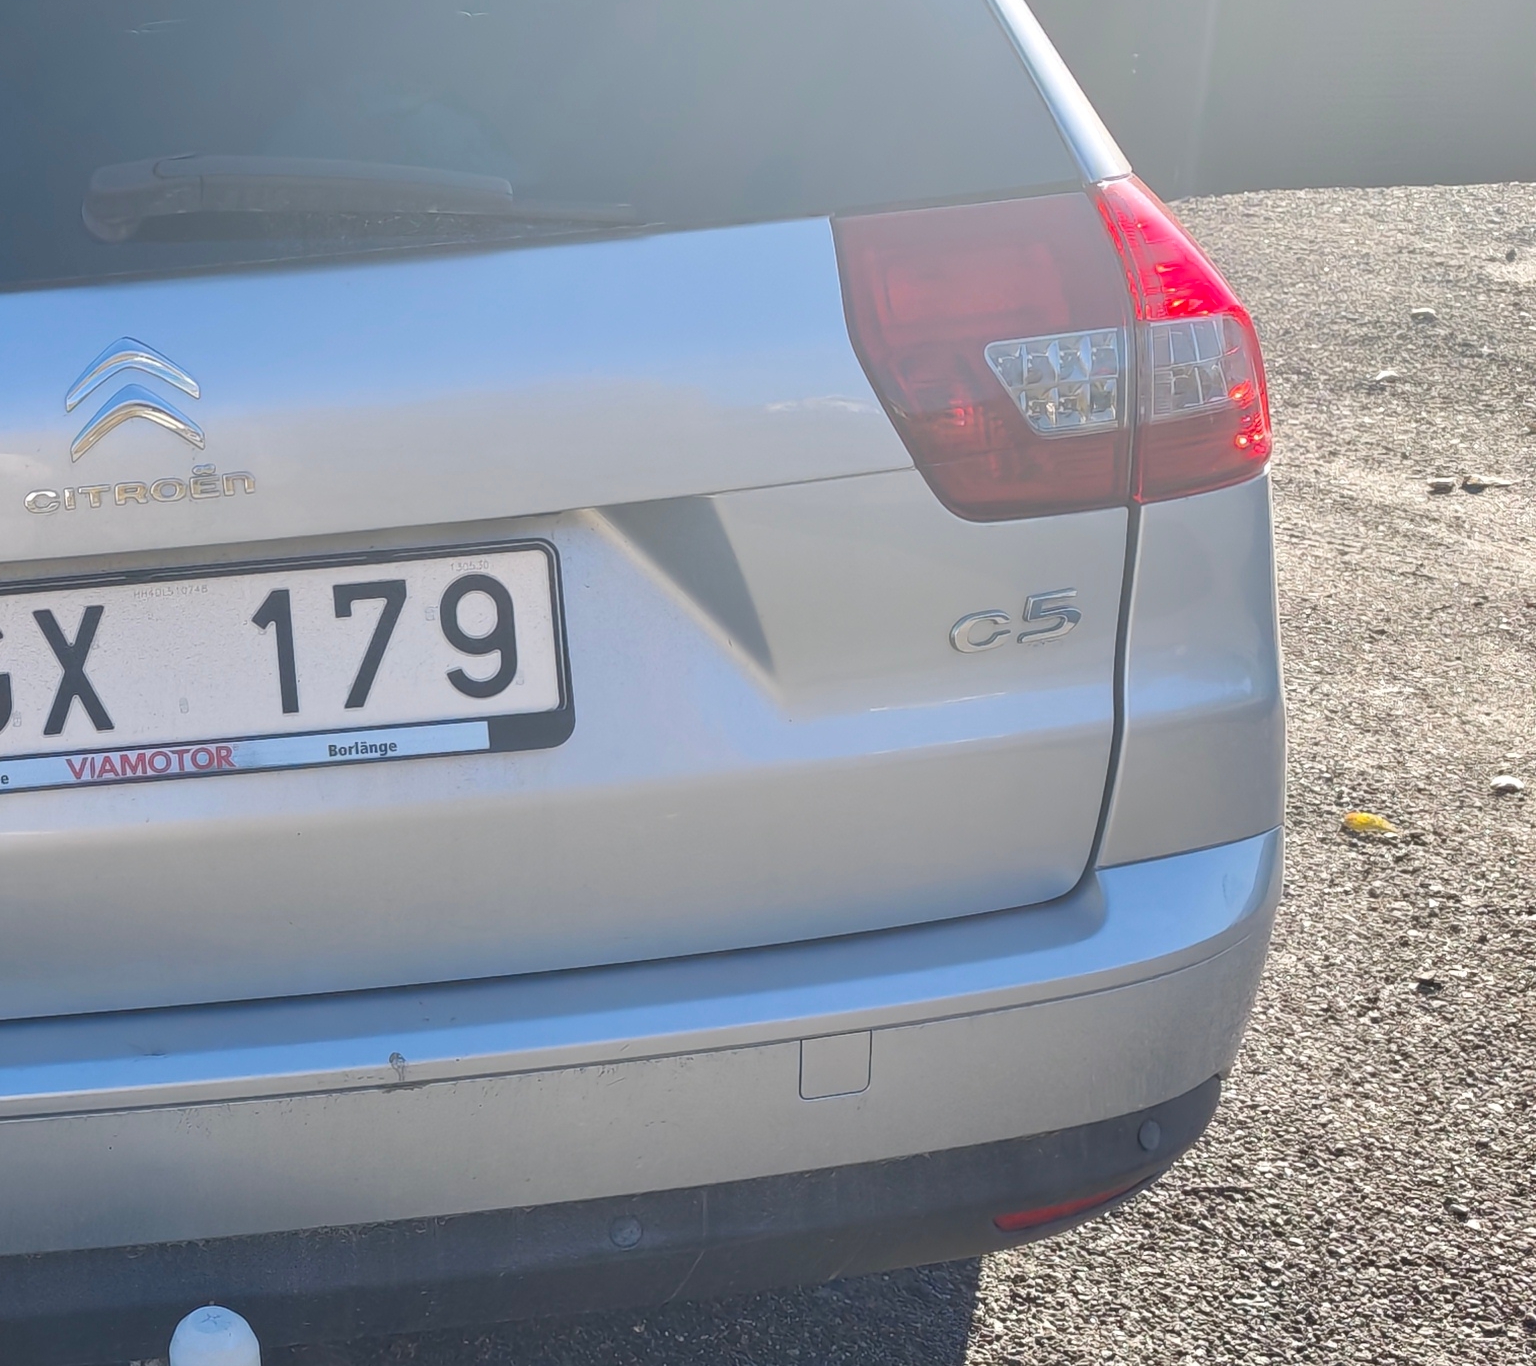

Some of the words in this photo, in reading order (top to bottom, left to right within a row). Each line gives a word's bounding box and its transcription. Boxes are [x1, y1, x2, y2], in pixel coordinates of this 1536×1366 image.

[251, 579, 518, 714] 179
[949, 587, 1082, 654] C5
[65, 745, 237, 781] VIAMOTOR
[327, 740, 398, 758] Borlänge
